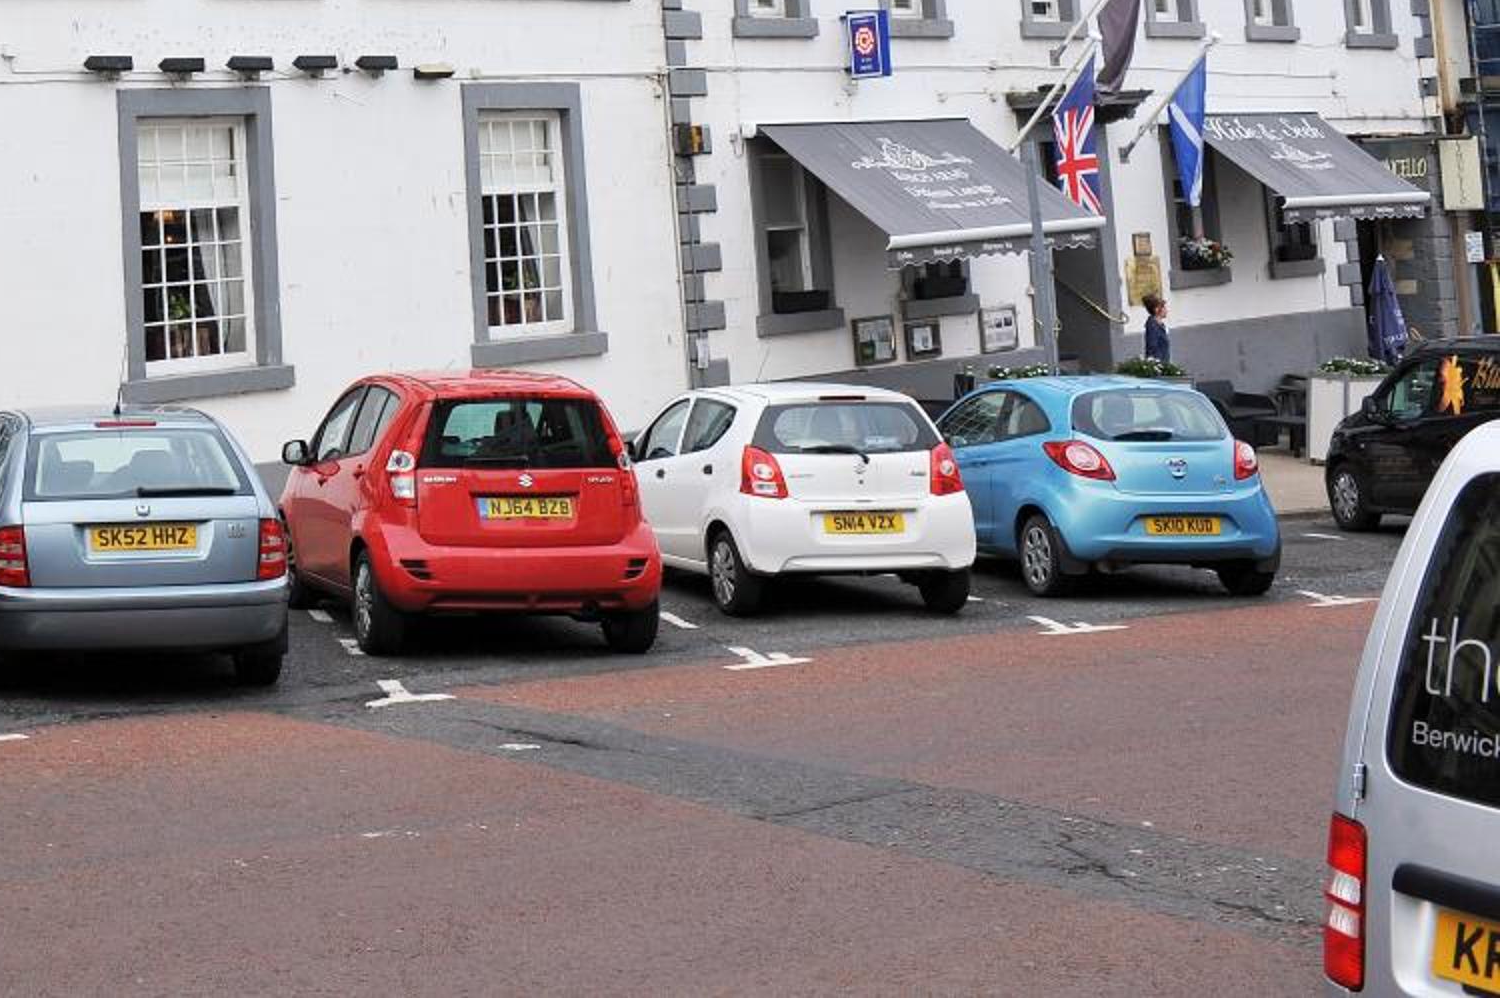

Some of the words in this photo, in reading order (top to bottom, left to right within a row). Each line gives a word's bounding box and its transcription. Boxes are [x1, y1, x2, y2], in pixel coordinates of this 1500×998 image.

[490, 501, 534, 515] NJ64
[539, 501, 570, 515] BZB
[833, 517, 866, 531] SN14
[869, 515, 896, 529] VZX
[98, 529, 148, 547] SK52
[153, 527, 189, 545] HHZ
[1422, 617, 1500, 702] th
